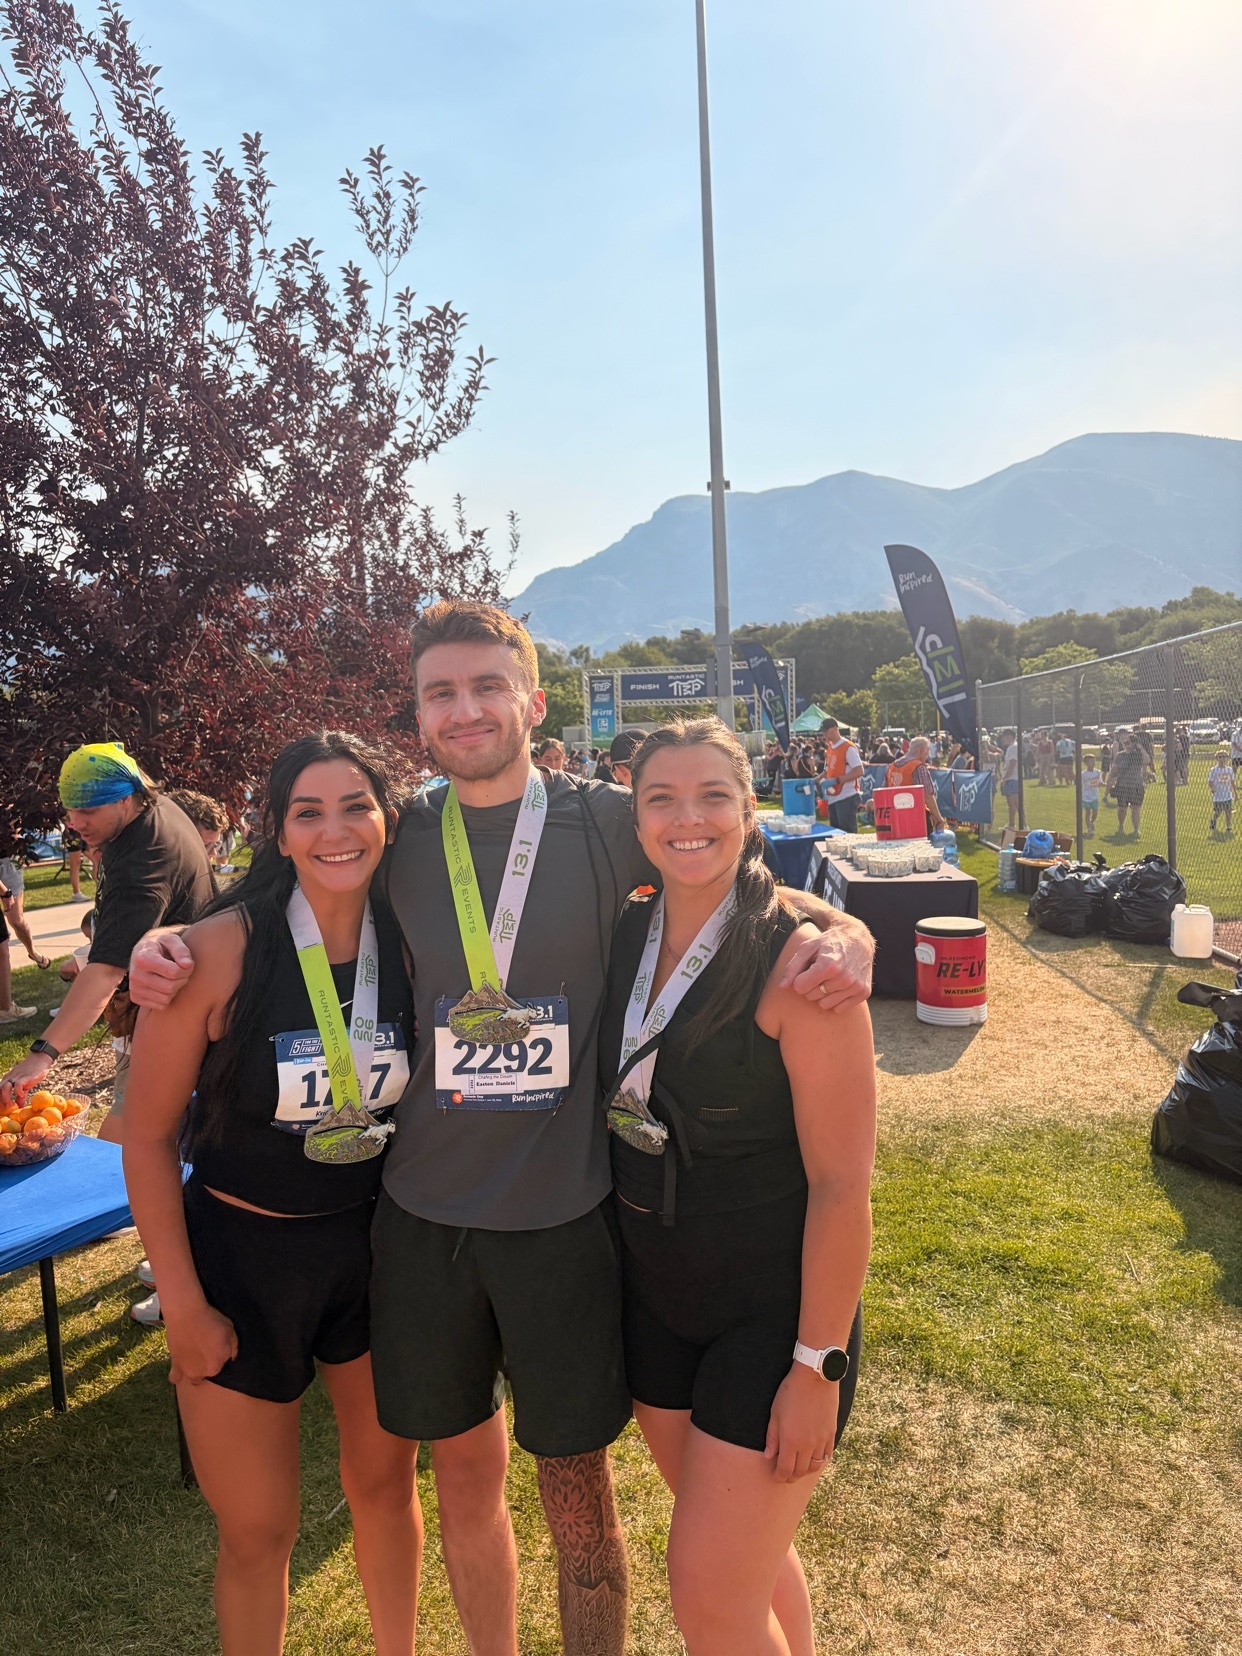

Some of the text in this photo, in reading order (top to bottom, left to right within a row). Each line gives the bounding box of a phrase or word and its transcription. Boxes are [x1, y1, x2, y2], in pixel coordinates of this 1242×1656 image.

[899, 571, 916, 584] Run
[447, 805, 462, 865] RUNTASTIC
[461, 888, 477, 934] EVENTS
[511, 839, 533, 877] 13.1
[492, 906, 504, 943] RUNTASTIC
[358, 952, 366, 986] RUNTASTIC
[680, 942, 712, 980] 13.1
[937, 959, 986, 978] RE-LY
[318, 989, 341, 1054] RUNTASTIC
[536, 1004, 553, 1019] 3.1
[353, 1016, 364, 1041] 20
[363, 1018, 374, 1043] 26
[374, 1031, 395, 1045] 3.1
[292, 1041, 301, 1054] 5
[301, 1045, 320, 1053] FIGHT
[452, 1036, 553, 1076] 2292
